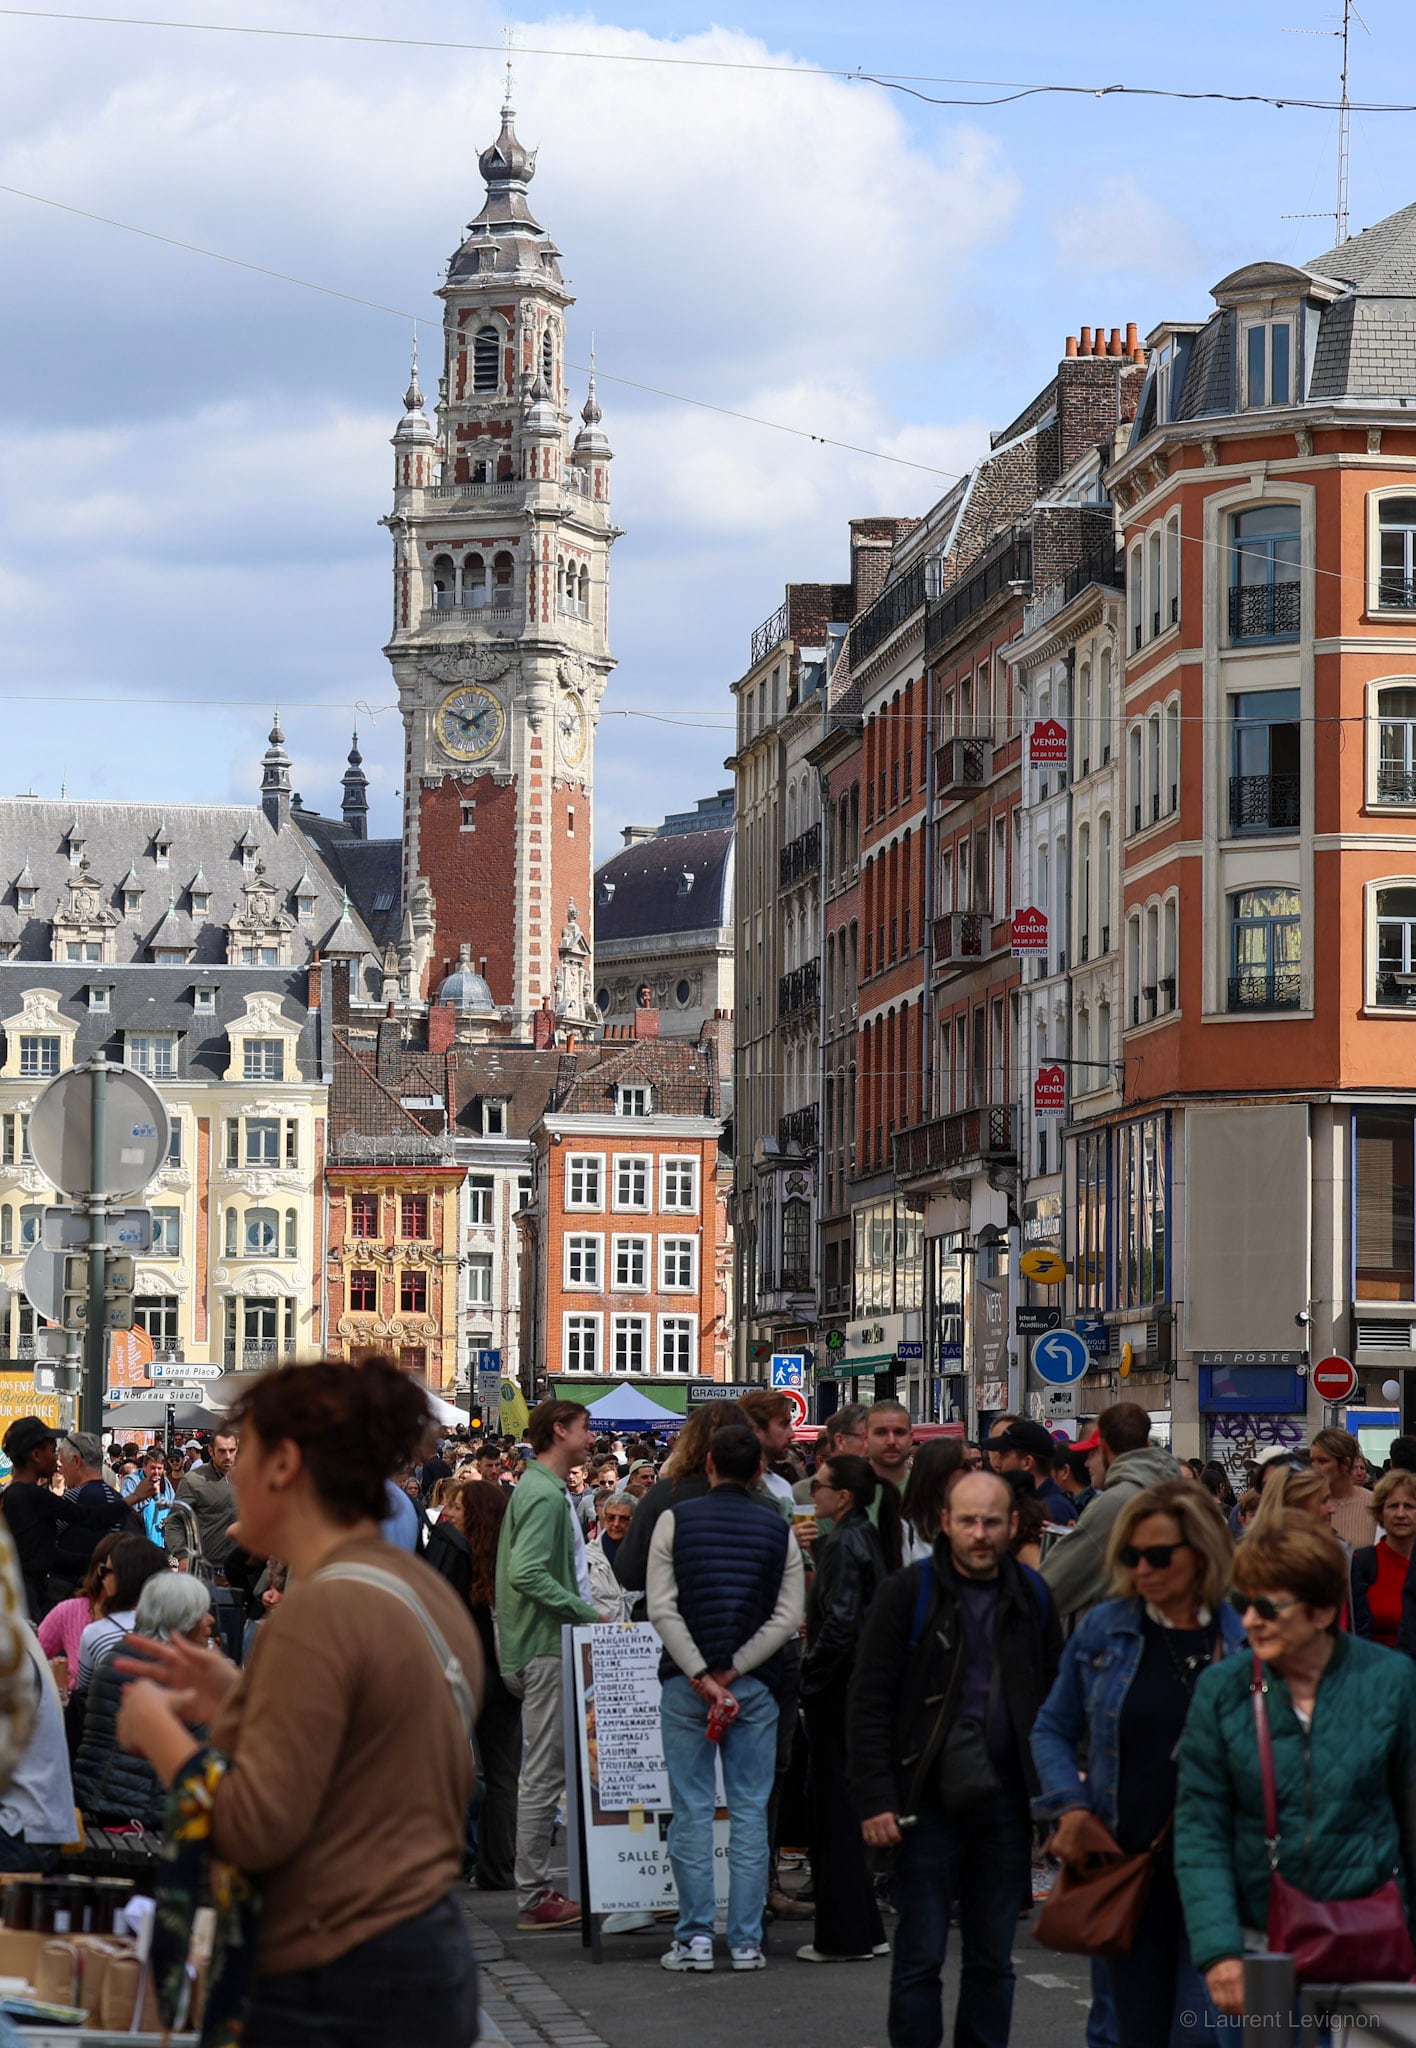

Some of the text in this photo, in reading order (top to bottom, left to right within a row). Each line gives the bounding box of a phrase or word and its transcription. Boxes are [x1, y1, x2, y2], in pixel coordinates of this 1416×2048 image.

[1048, 728, 1055, 736] A
[1029, 915, 1036, 923] A
[1052, 1075, 1059, 1083] A
[899, 1346, 921, 1355] PAP
[1202, 1354, 1290, 1362] LA POSTE
[194, 1368, 215, 1376] Place
[170, 1391, 199, 1399] Siècle
[692, 1389, 727, 1397] GRAND
[26, 1405, 54, 1417] FOIRE
[594, 1625, 640, 1635] PIZZAS
[593, 1635, 653, 1644] MARGHERITA
[593, 1647, 652, 1656] MARGHERITA
[595, 1671, 635, 1679] POULETTE
[595, 1683, 635, 1691] CHORIZO
[597, 1719, 656, 1727] CAMPAGNARDE
[606, 1732, 650, 1741] FROMAGES
[599, 1747, 637, 1756] SAUMON
[618, 1850, 660, 1862] SALLE
[638, 1865, 656, 1876] 40
[618, 1901, 640, 1909] PLACE
